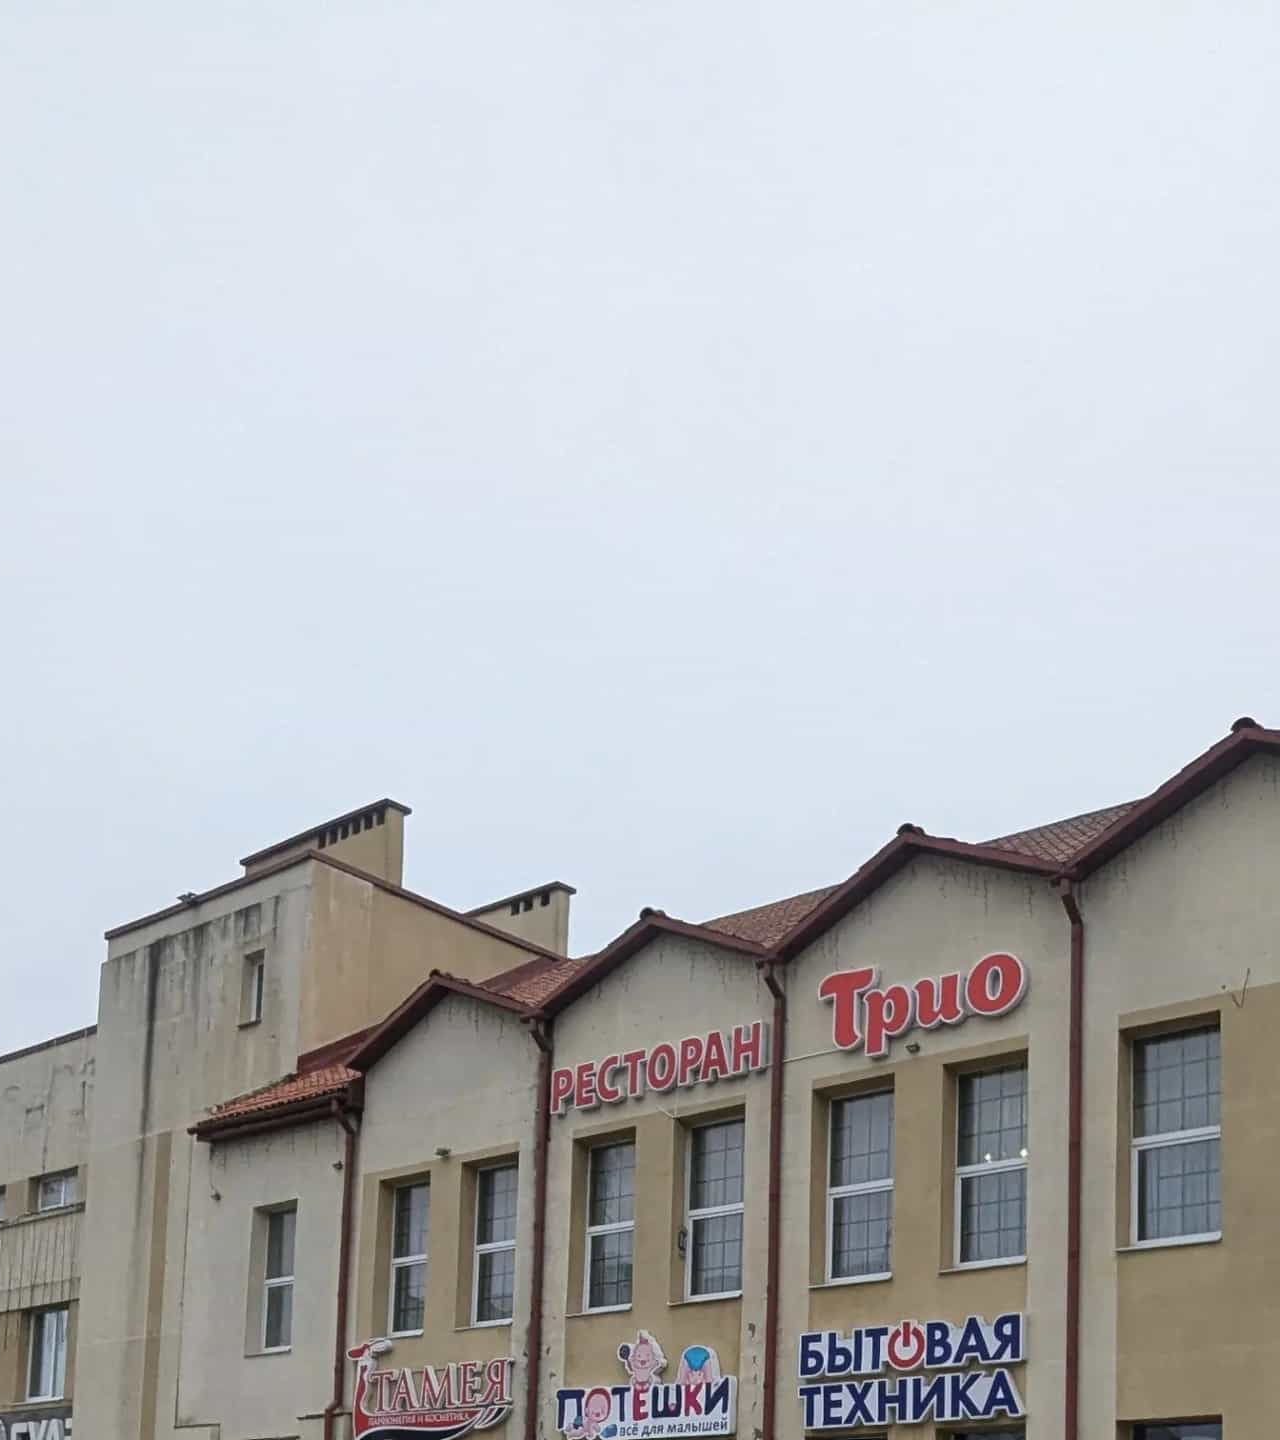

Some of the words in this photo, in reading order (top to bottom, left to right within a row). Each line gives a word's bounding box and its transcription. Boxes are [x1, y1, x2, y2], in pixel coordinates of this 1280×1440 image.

[550, 1020, 762, 1114] РЕСТОРАН
[800, 1314, 1022, 1377] БЫТОВАЯ
[371, 1358, 511, 1413] ТАМЕЯ
[556, 1377, 730, 1430] ПОТЕШКИ
[799, 1369, 1020, 1427] ТЕХНИКА
[619, 1423, 639, 1437] всё
[641, 1425, 664, 1438] для
[667, 1416, 729, 1434] малышей
